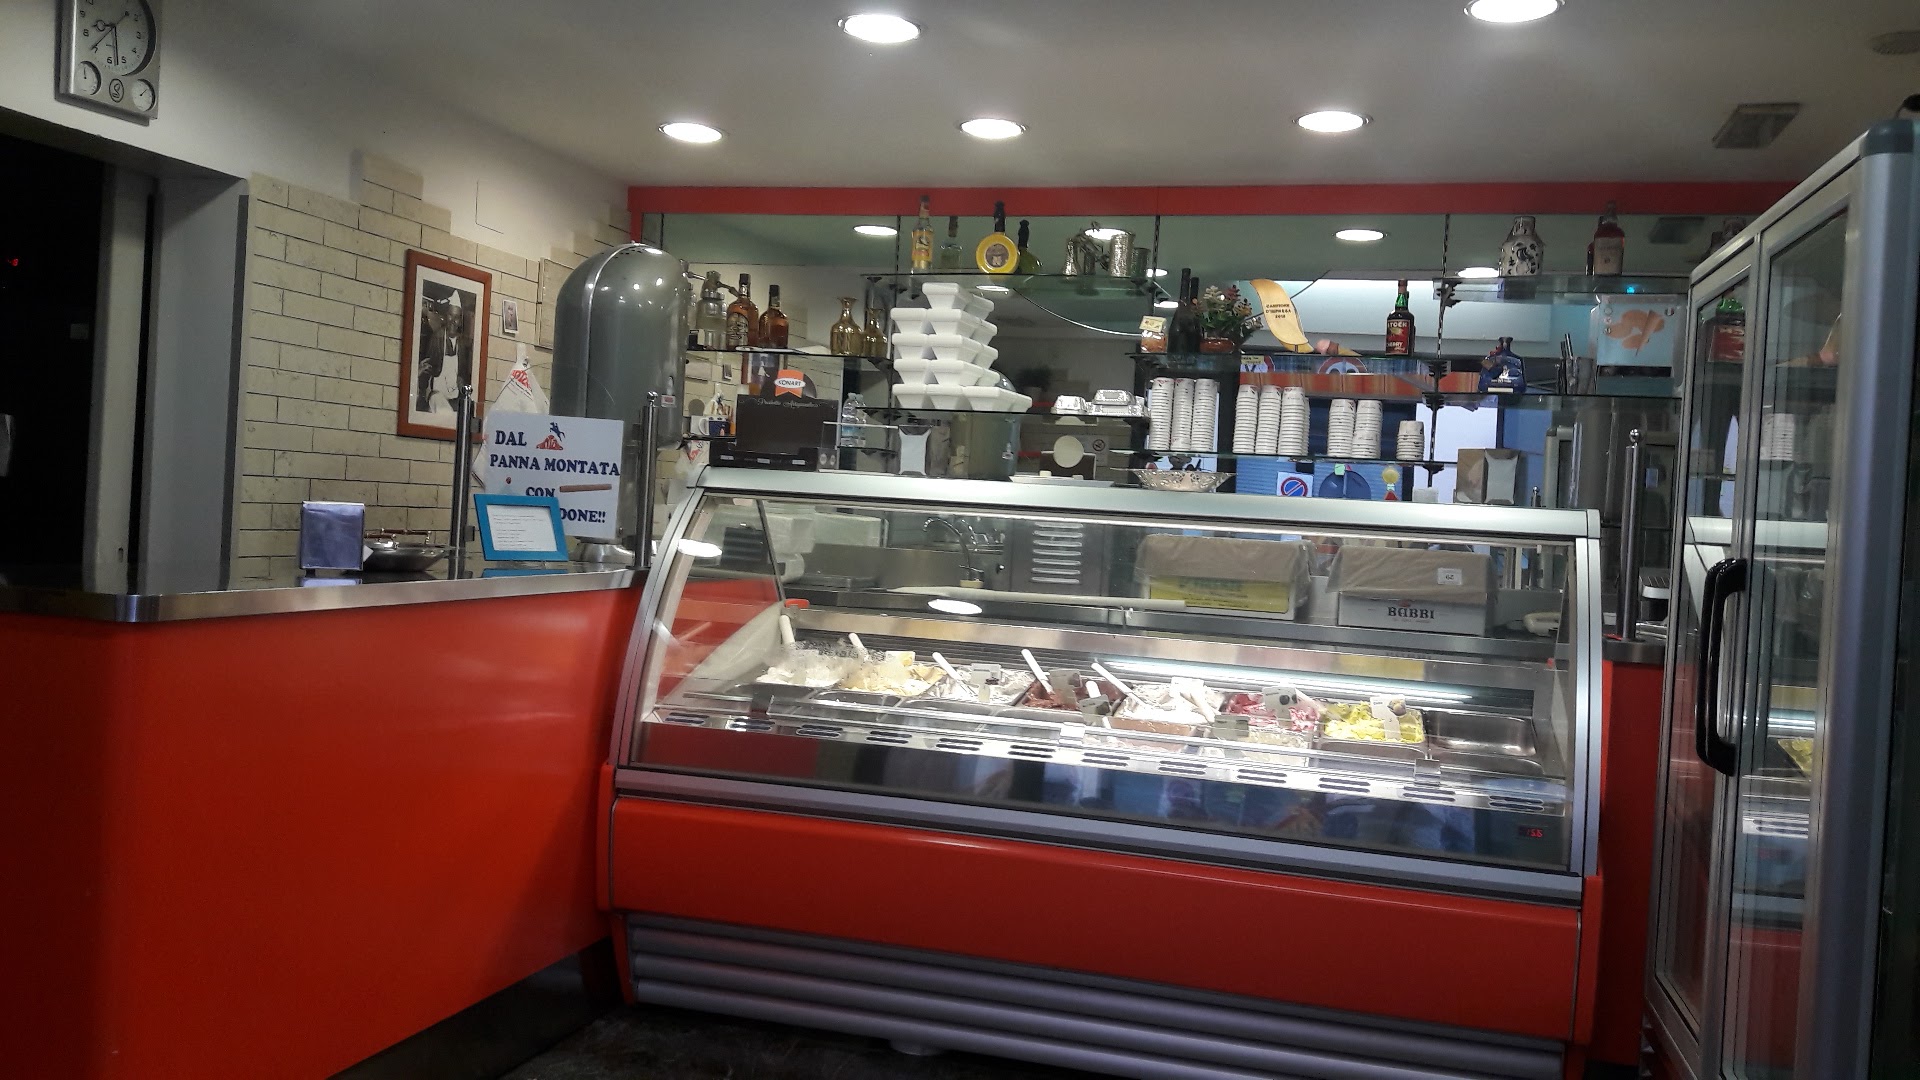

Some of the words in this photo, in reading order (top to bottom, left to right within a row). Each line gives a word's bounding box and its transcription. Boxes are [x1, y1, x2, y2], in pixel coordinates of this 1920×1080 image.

[495, 429, 527, 447] DAL
[490, 453, 540, 471] PANNA
[543, 457, 621, 476] MONTATA
[1387, 606, 1435, 619] BABBI
